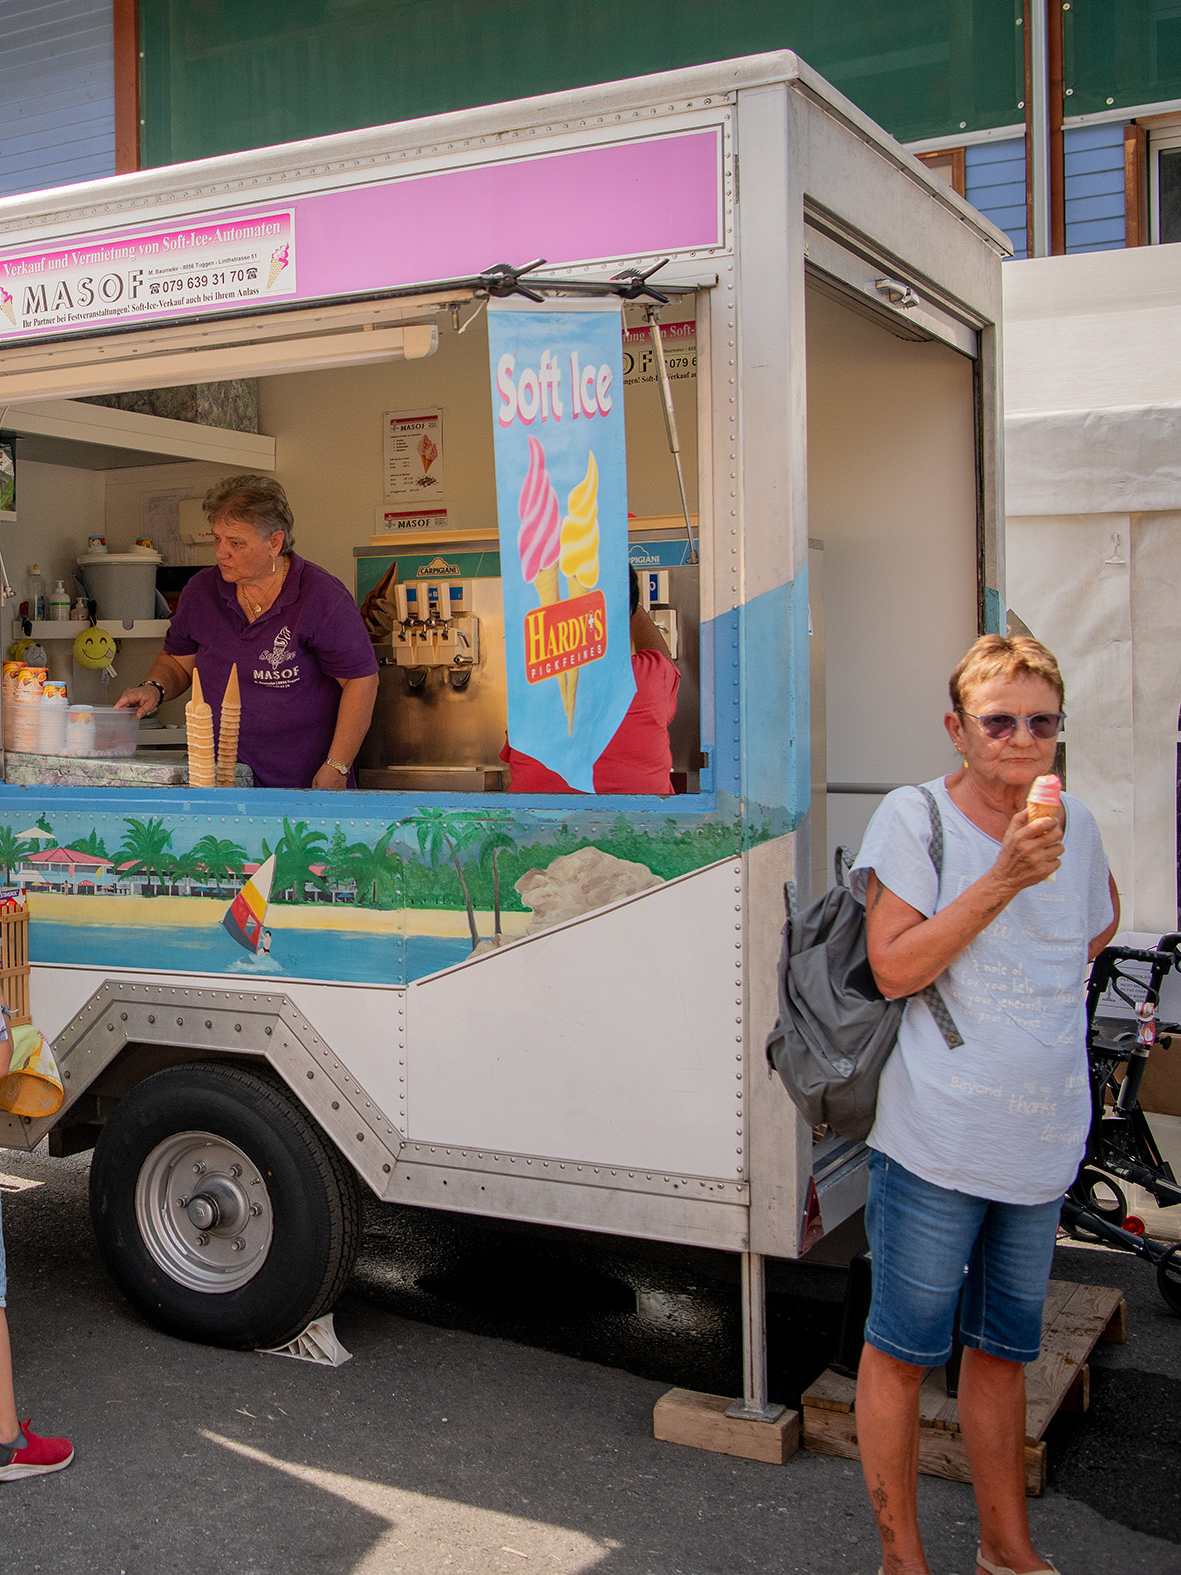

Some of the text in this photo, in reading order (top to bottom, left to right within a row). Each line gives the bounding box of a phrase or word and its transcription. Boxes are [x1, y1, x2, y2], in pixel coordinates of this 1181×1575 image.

[4, 221, 281, 277] Verkauf und Vermietung von Soft-Ice-Automaten
[195, 261, 214, 270] Tuggen
[22, 269, 144, 315] MASOF
[163, 269, 244, 293] 079 639 31 70
[22, 287, 260, 329] Ihr Partner bei Festveranstaltungen! Soft-Ice-Verkauf auch bei Ihrem Anlass
[669, 357, 688, 368] 079
[496, 350, 613, 428] Soft Ice
[398, 518, 431, 529] MASOF
[420, 567, 457, 575] CARPIGIANI
[253, 665, 300, 680] MASOF
[531, 643, 603, 679] PICKFEINES
[949, 1075, 1003, 1098] Beyond
